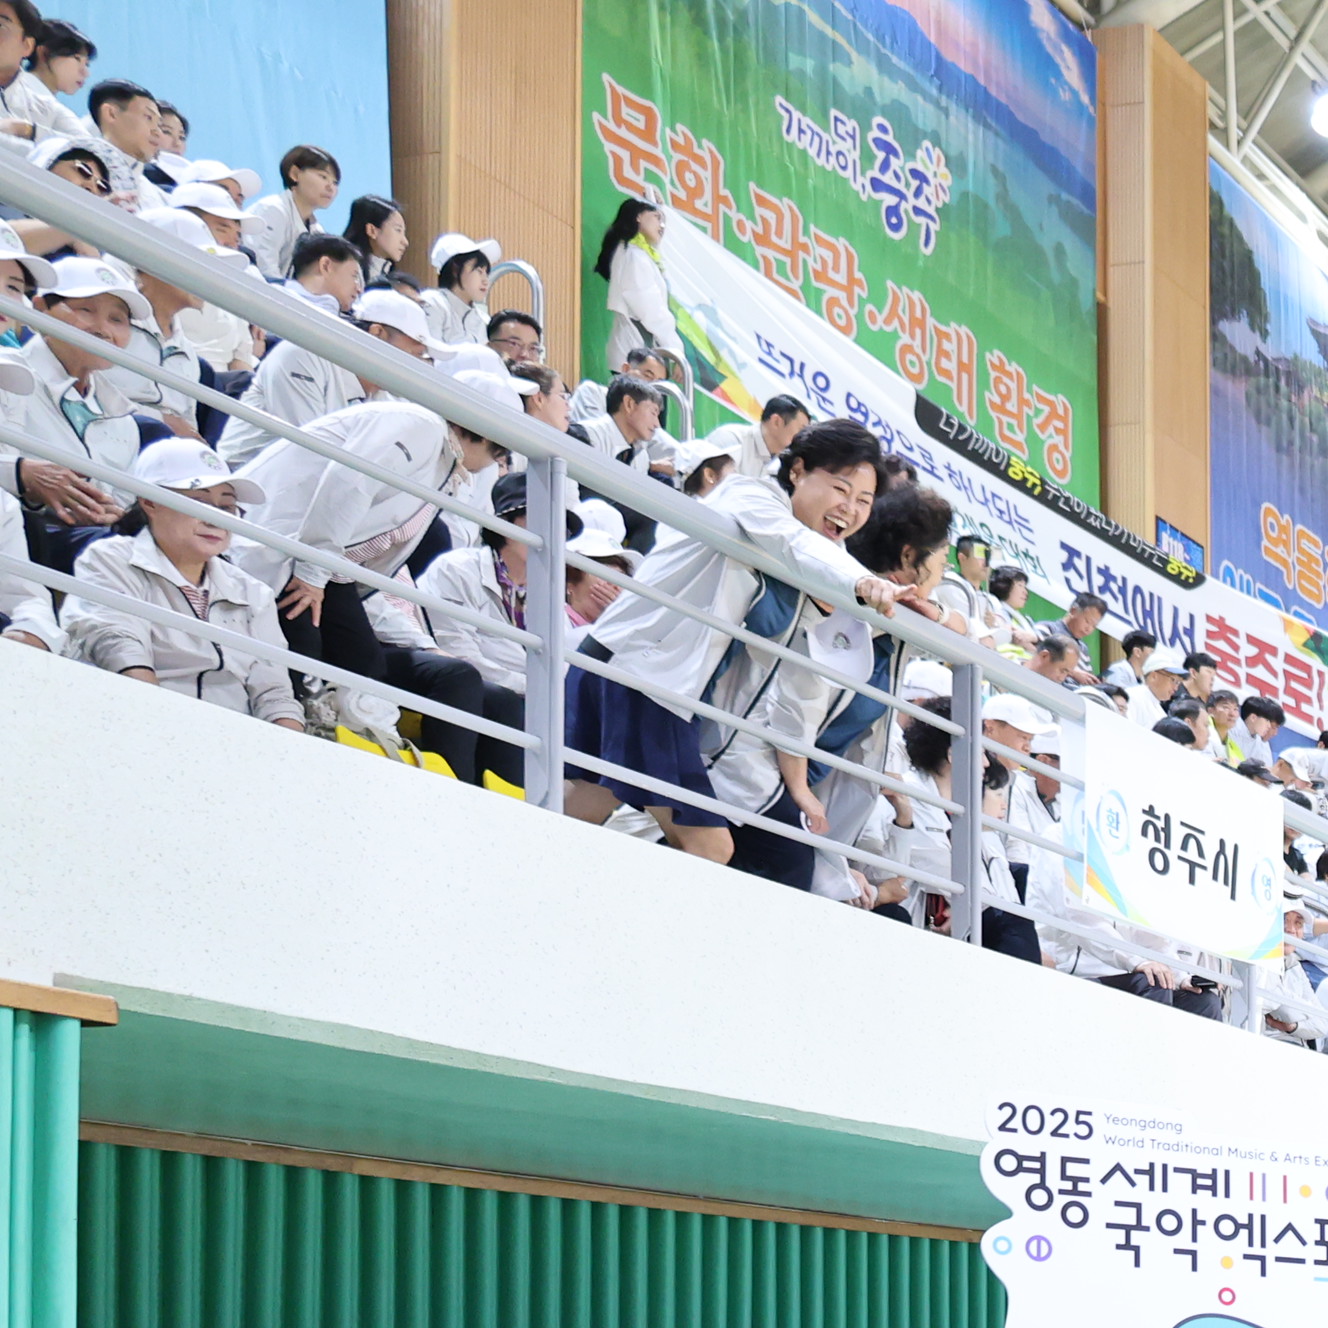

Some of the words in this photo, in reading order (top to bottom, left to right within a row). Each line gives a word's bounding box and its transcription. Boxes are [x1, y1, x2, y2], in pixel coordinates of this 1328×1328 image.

[871, 122, 938, 249] 충주
[755, 332, 836, 418] 뜨거운
[944, 460, 1036, 547] 하나되는
[987, 352, 1070, 480] 환경
[1059, 540, 1196, 655] 진천에서
[1204, 613, 1326, 731] 충주로!
[1141, 804, 1239, 901] 청주시
[997, 1102, 1095, 1141] 2025
[1103, 1113, 1183, 1134] Yeongdong
[1103, 1134, 1145, 1150] World
[1149, 1138, 1223, 1157] Traditional
[1227, 1146, 1266, 1162] Music
[1269, 1150, 1279, 1162] &
[1283, 1152, 1310, 1167] Arts
[994, 1148, 1231, 1228] 영동세계
